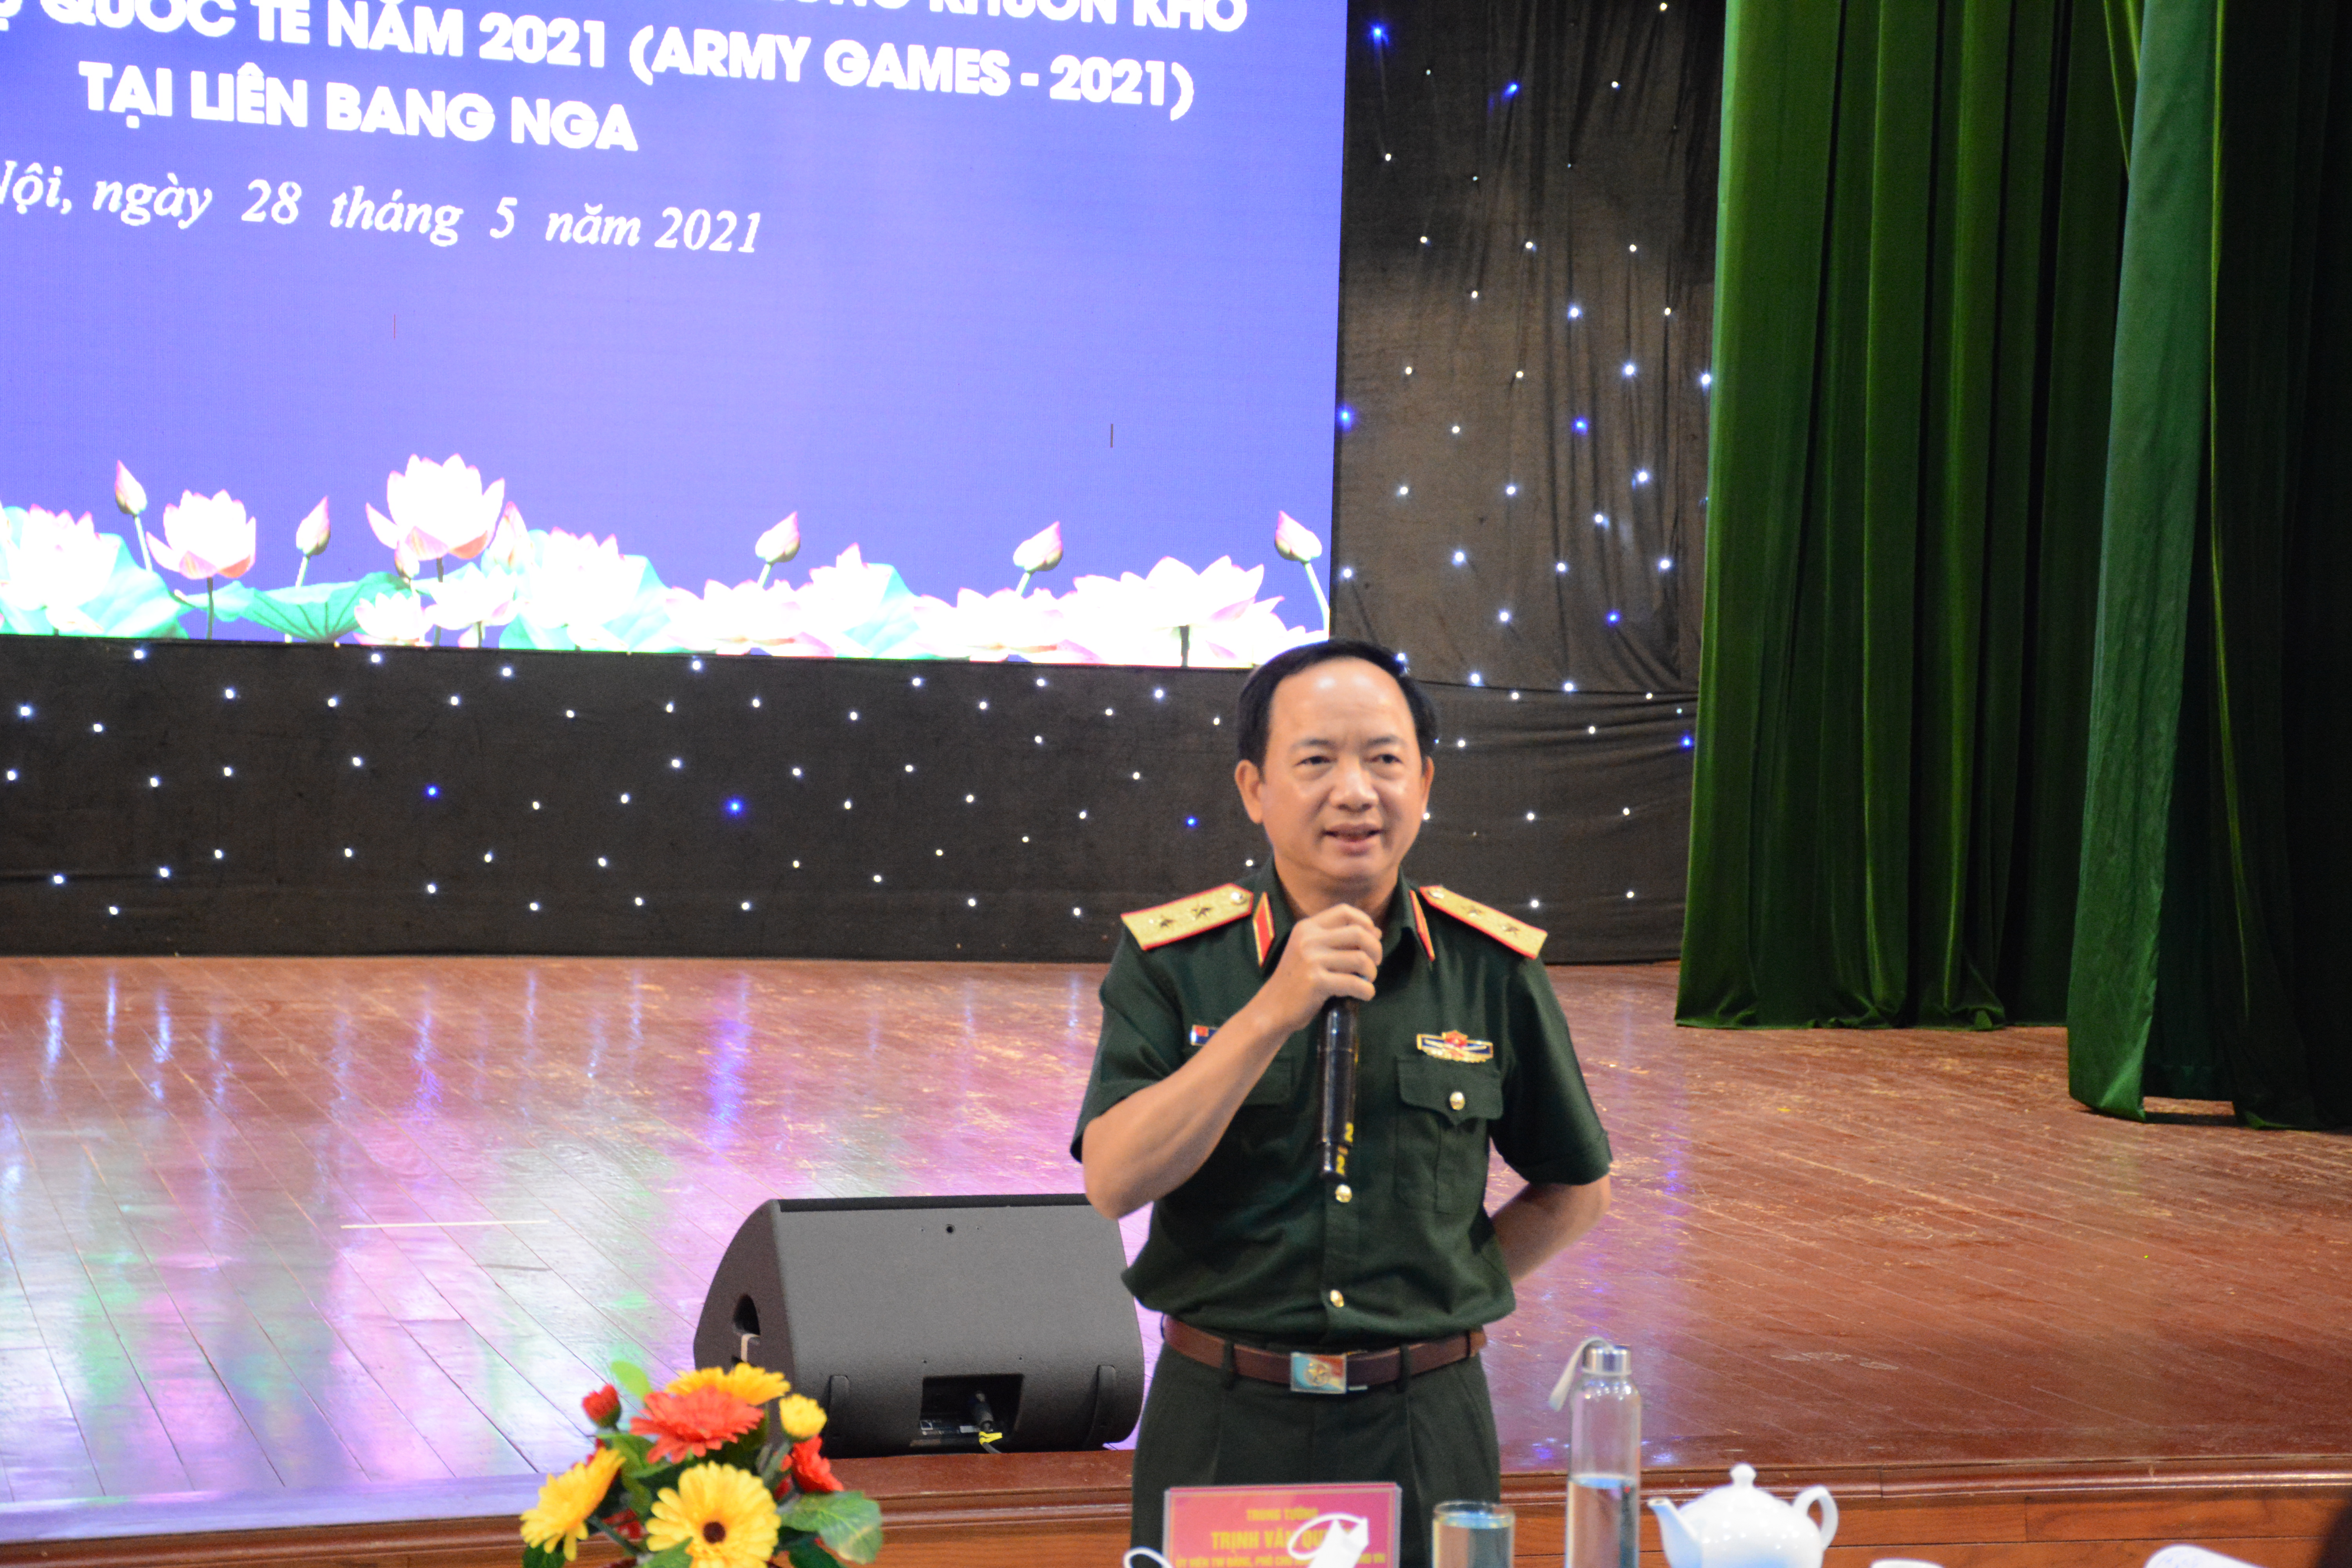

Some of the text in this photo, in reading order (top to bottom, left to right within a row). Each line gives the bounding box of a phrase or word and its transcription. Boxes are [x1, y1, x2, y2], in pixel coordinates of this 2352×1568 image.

[78, 61, 639, 152] TẠI LIÊN BANG NGA
[479, 12, 605, 68] 2021
[628, 24, 812, 85] (ARMY
[823, 38, 1011, 96] GAMES
[1049, 54, 1195, 122] 2021)
[92, 172, 212, 229] ngày
[241, 179, 302, 225] 28
[329, 185, 464, 247] tháng
[489, 196, 518, 239] 5
[544, 202, 641, 247] năm
[654, 207, 761, 253] 2021
[1211, 1530, 1259, 1553] TRỊNH
